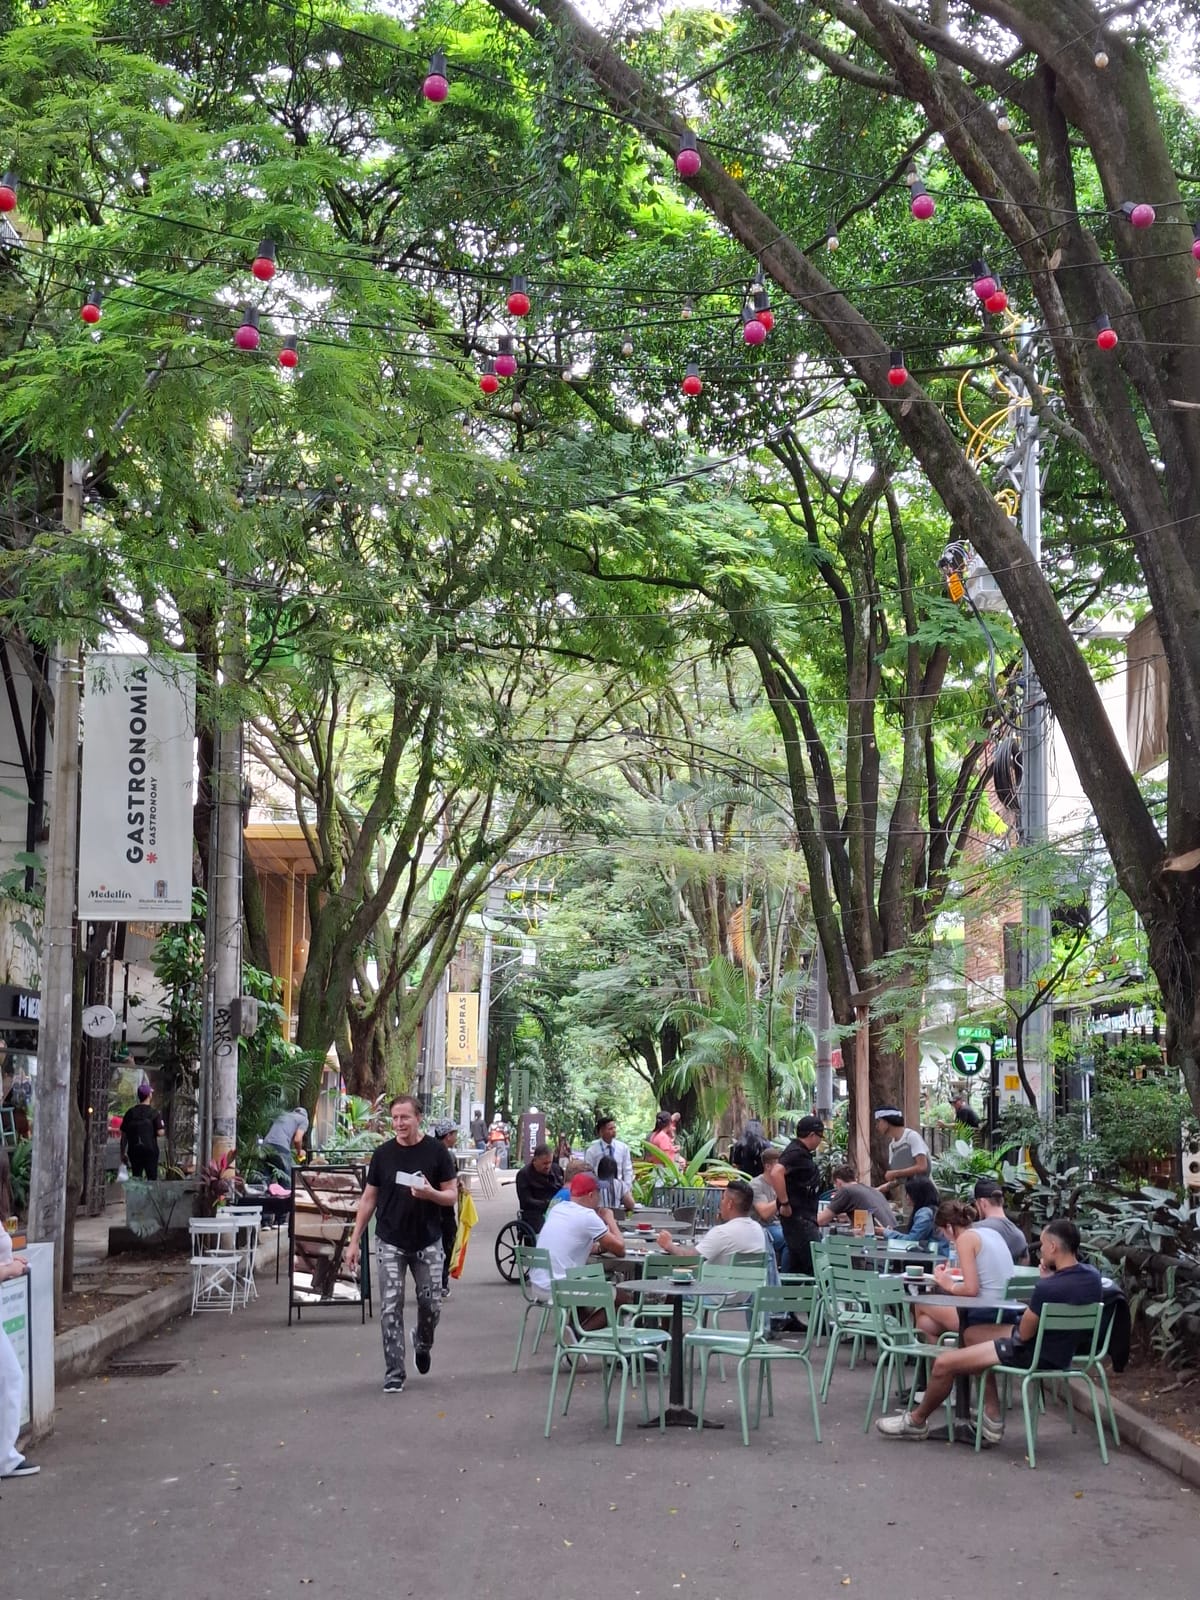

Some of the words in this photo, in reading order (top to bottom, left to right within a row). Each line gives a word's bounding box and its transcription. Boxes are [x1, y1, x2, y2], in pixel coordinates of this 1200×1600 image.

[124, 665, 148, 864] GASTRONOMÍA
[149, 776, 158, 846] GASTRONOMY
[88, 889, 132, 899] Medellín
[458, 997, 467, 1049] COMPRAS
